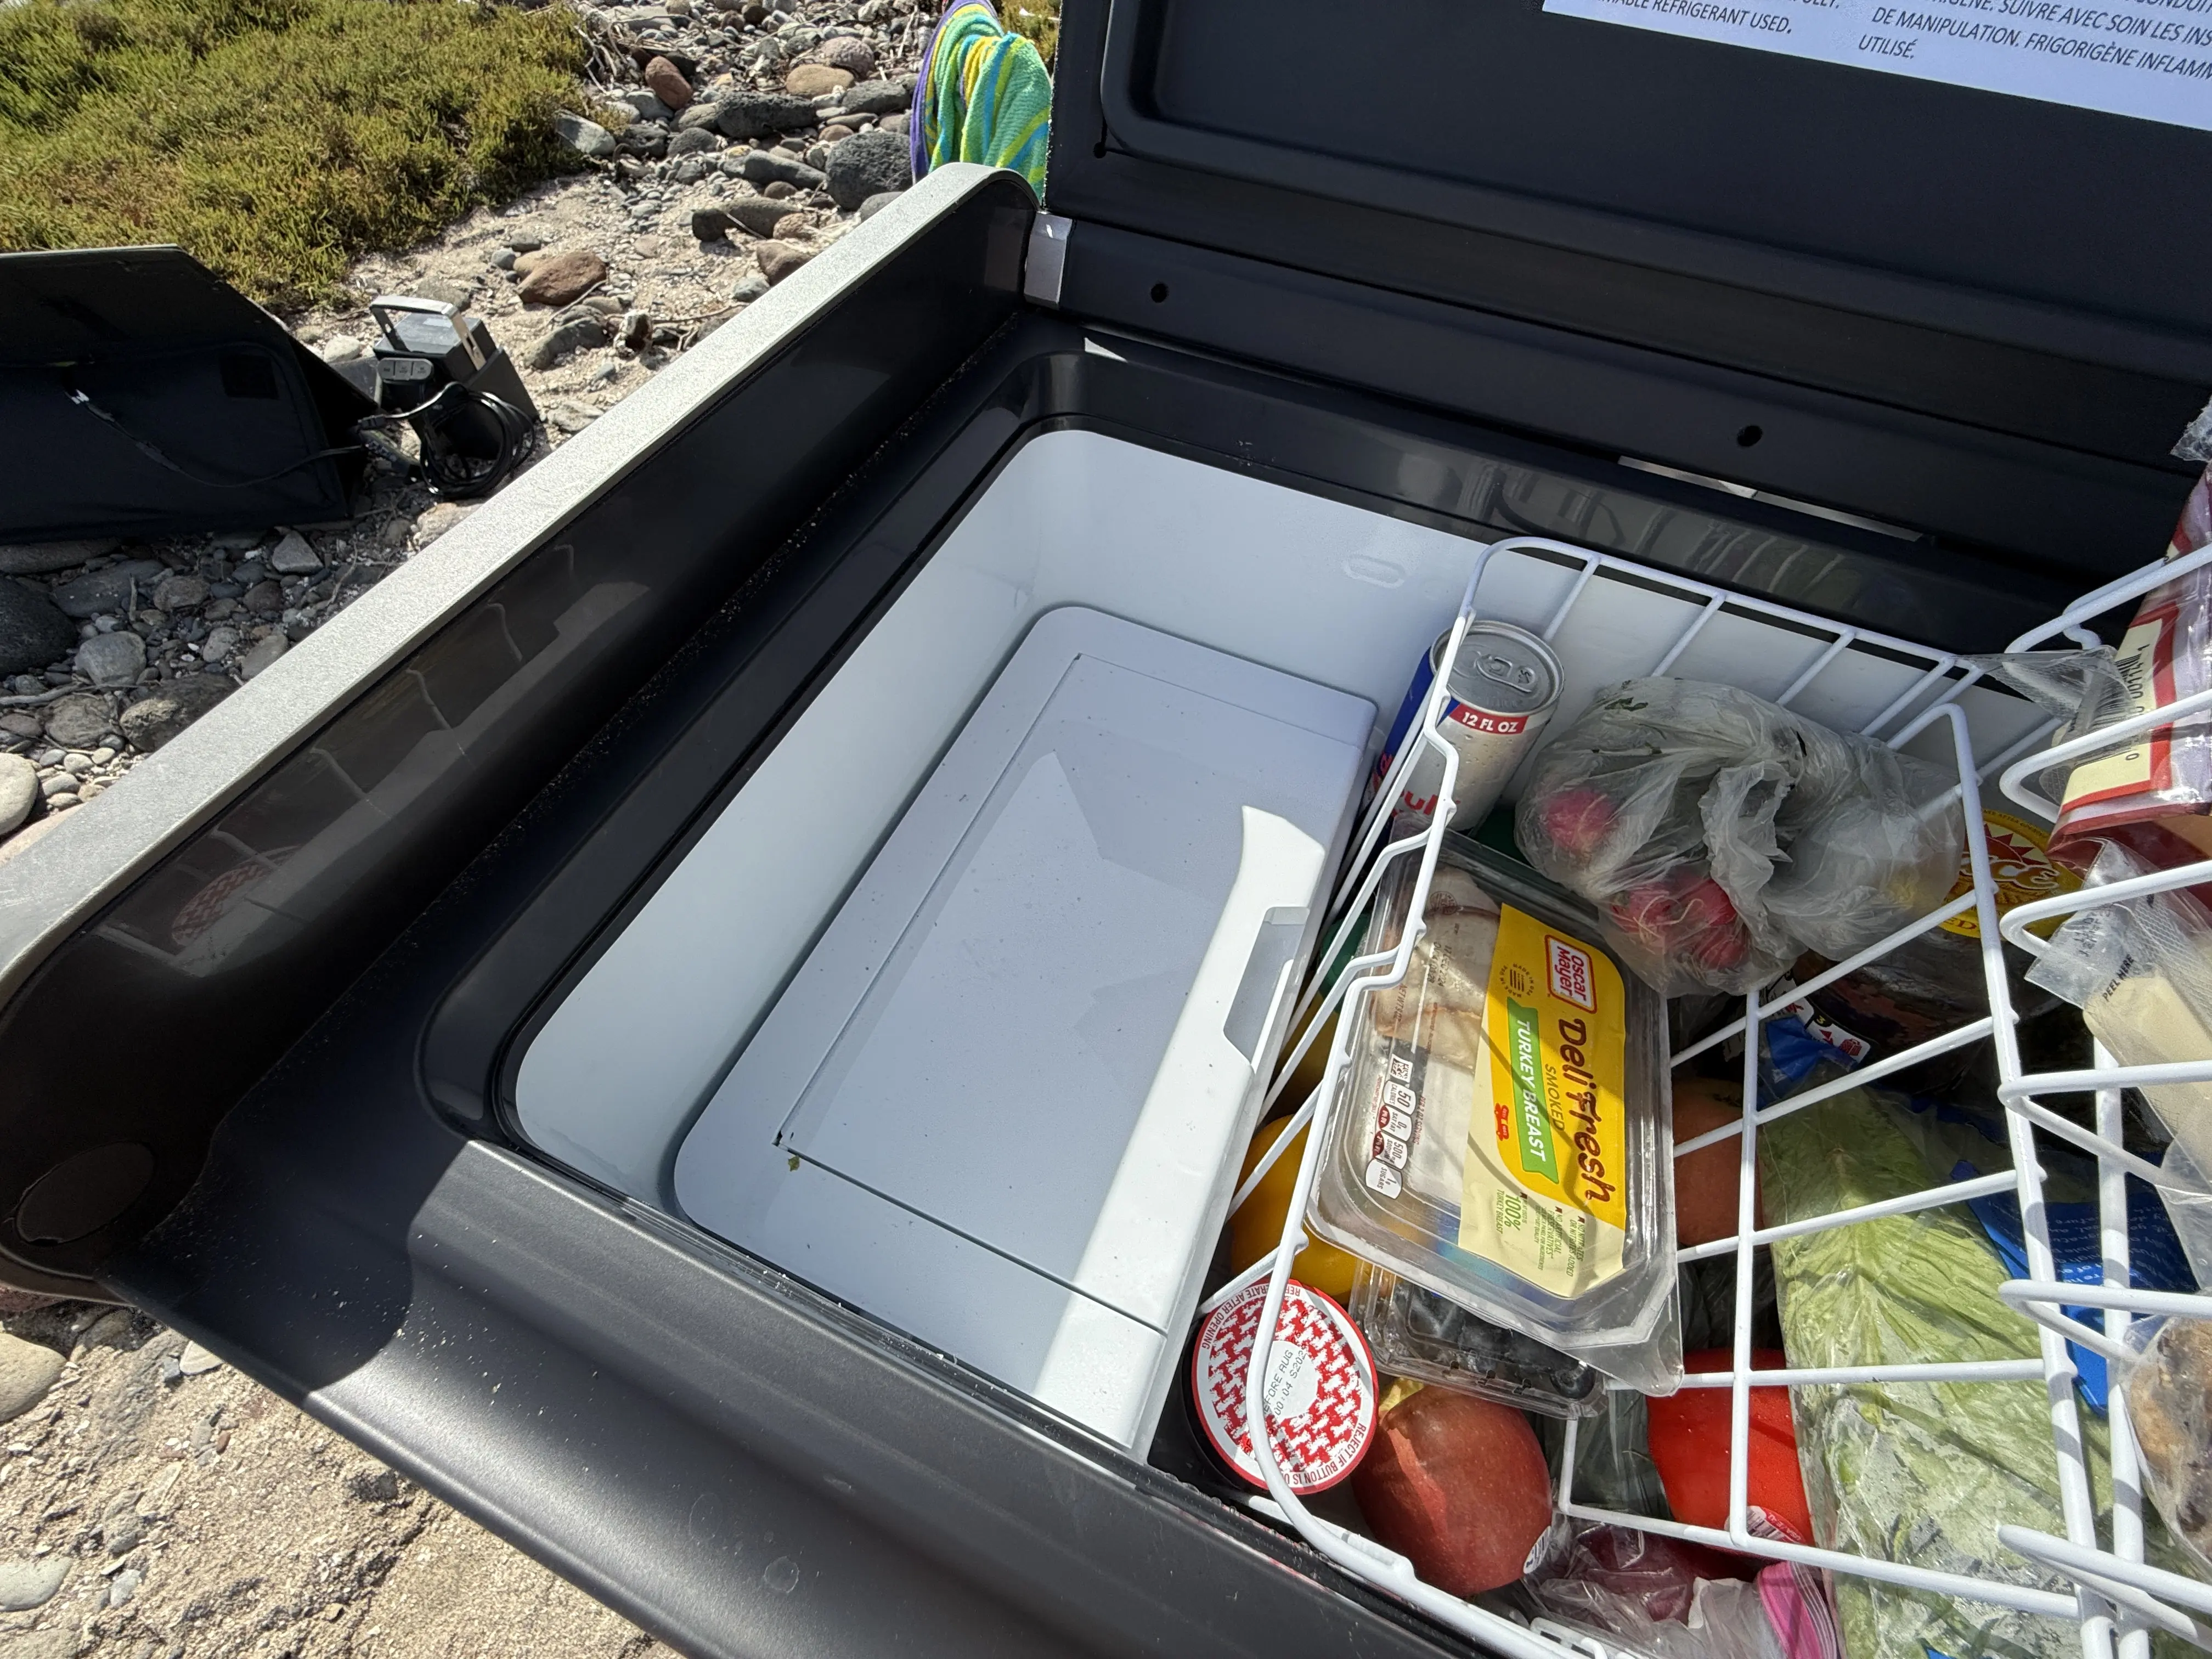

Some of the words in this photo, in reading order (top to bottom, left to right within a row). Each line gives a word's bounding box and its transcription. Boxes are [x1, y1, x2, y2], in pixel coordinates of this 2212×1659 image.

[1652, 0, 1750, 25] REFRIGERANT
[1750, 12, 1792, 33] USED.
[1998, 0, 2061, 21] SUIVRE
[2056, 7, 2108, 29] AVEC
[2106, 14, 2154, 36] SOIN
[2149, 21, 2185, 42] LES
[1859, 34, 1918, 59] UTILISÉ.
[1872, 7, 1897, 25] DE
[1895, 11, 2021, 47] MANIPULATION.
[2023, 33, 2139, 66] FRIGORIGÈNE
[1462, 712, 1479, 726] 12
[1480, 718, 1494, 731] FL
[1498, 721, 1519, 733] OZ
[1554, 945, 1572, 997] Mayer
[1571, 955, 1587, 1001] Oscar
[2102, 979, 2121, 1002] PEEL
[2115, 953, 2135, 981] HERE
[1517, 1020, 1536, 1089] TURKEY
[1558, 1018, 1596, 1090] Deli
[1389, 1084, 1397, 1104] CALORIES
[1397, 1091, 1412, 1108] 50
[1545, 1063, 1565, 1131] SMOKED
[1523, 1088, 1546, 1162] BREAST
[1566, 1091, 1616, 1202] Fresh
[1377, 1167, 1387, 1189] SUGARS
[1504, 1194, 1521, 1231] 100%
[1555, 1214, 1562, 1222] NO
[1570, 1219, 1577, 1228] OR
[1578, 1223, 1585, 1231] NO
[1554, 1222, 1562, 1254] ARTIFICIAL
[1566, 1254, 1576, 1277] ADDED
[1224, 1293, 1244, 1314] AFTER
[1245, 1283, 1301, 1299] REFRATE
[1201, 1312, 1224, 1350] OPENING
[1263, 1373, 1283, 1414] EFORE
[1279, 1350, 1294, 1374] AUG
[1345, 1423, 1367, 1459] REJECT
[1304, 1461, 1339, 1483] BUTTON
[1338, 1454, 1347, 1468] IF
[1284, 1473, 1290, 1485] U
[1293, 1474, 1302, 1485] IS
